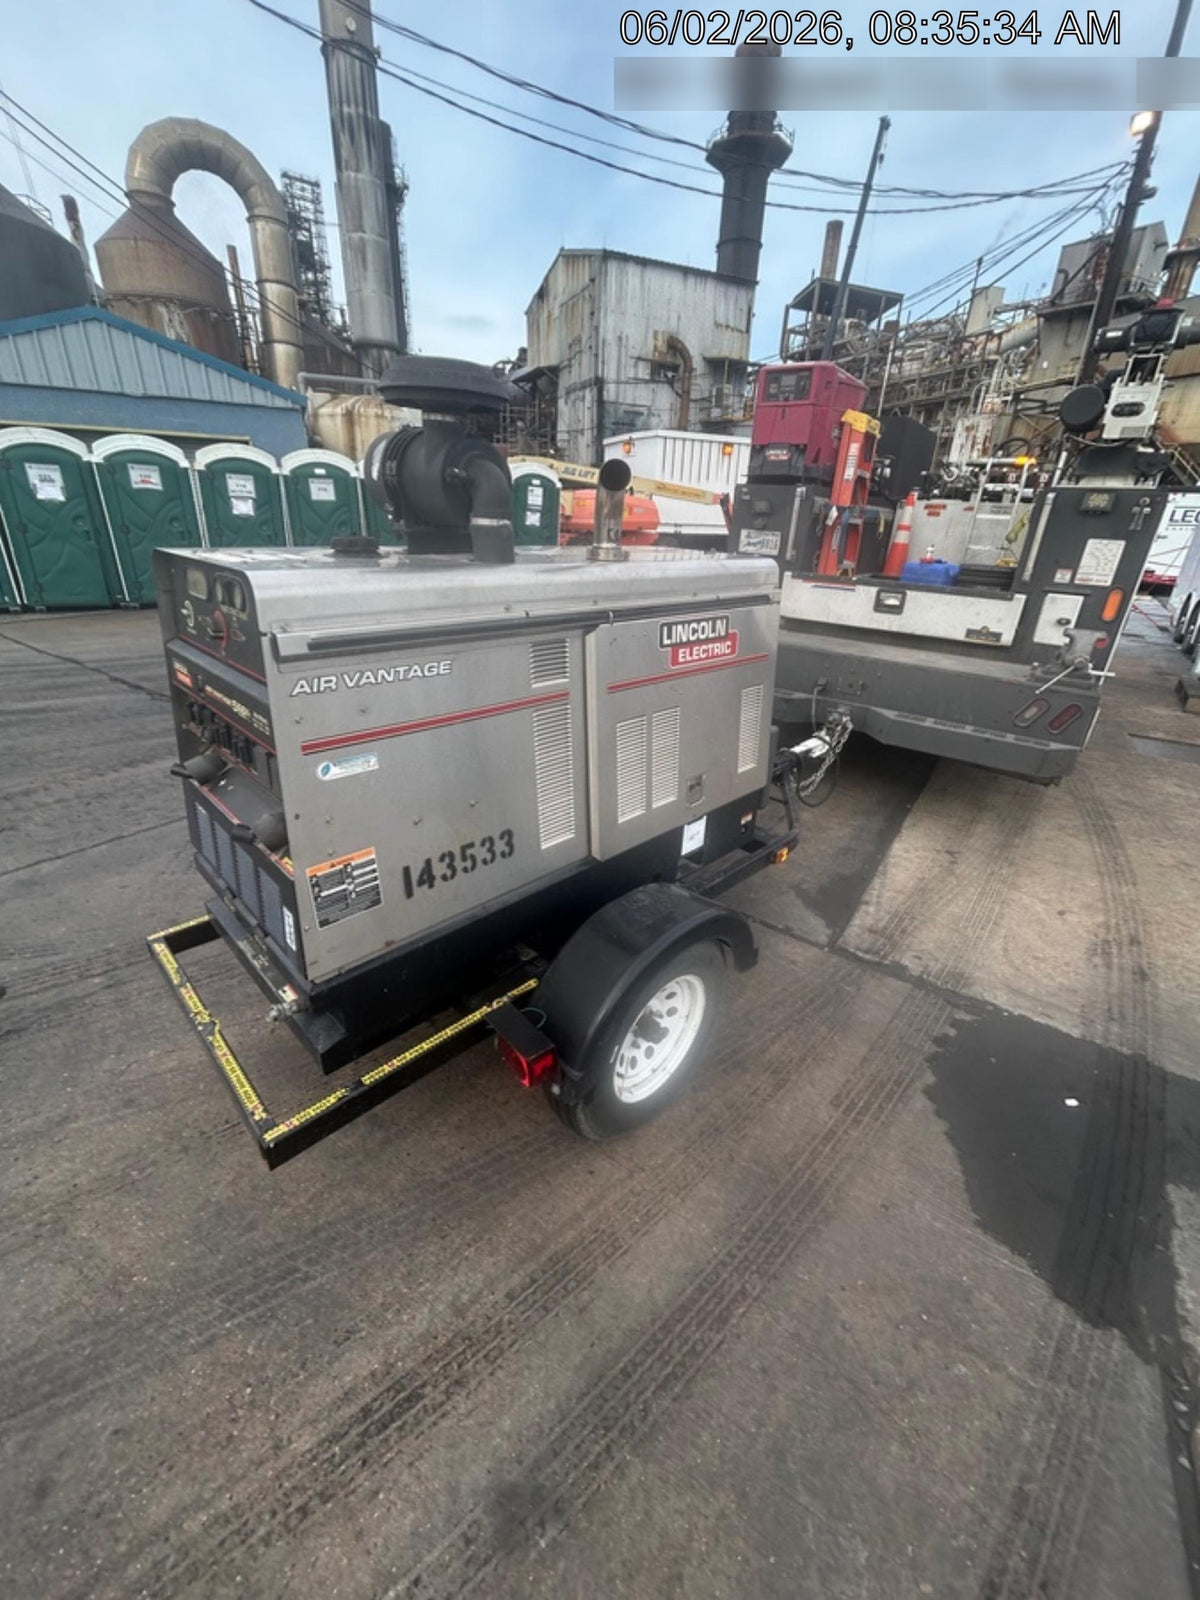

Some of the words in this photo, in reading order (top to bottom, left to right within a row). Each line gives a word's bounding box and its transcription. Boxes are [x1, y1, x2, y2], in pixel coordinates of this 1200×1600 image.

[662, 619, 727, 645] LINCOLN
[678, 641, 732, 662] ELECTRIC
[290, 675, 338, 698] AIR
[341, 660, 453, 689] VANTAGE
[402, 828, 515, 900] 143533
